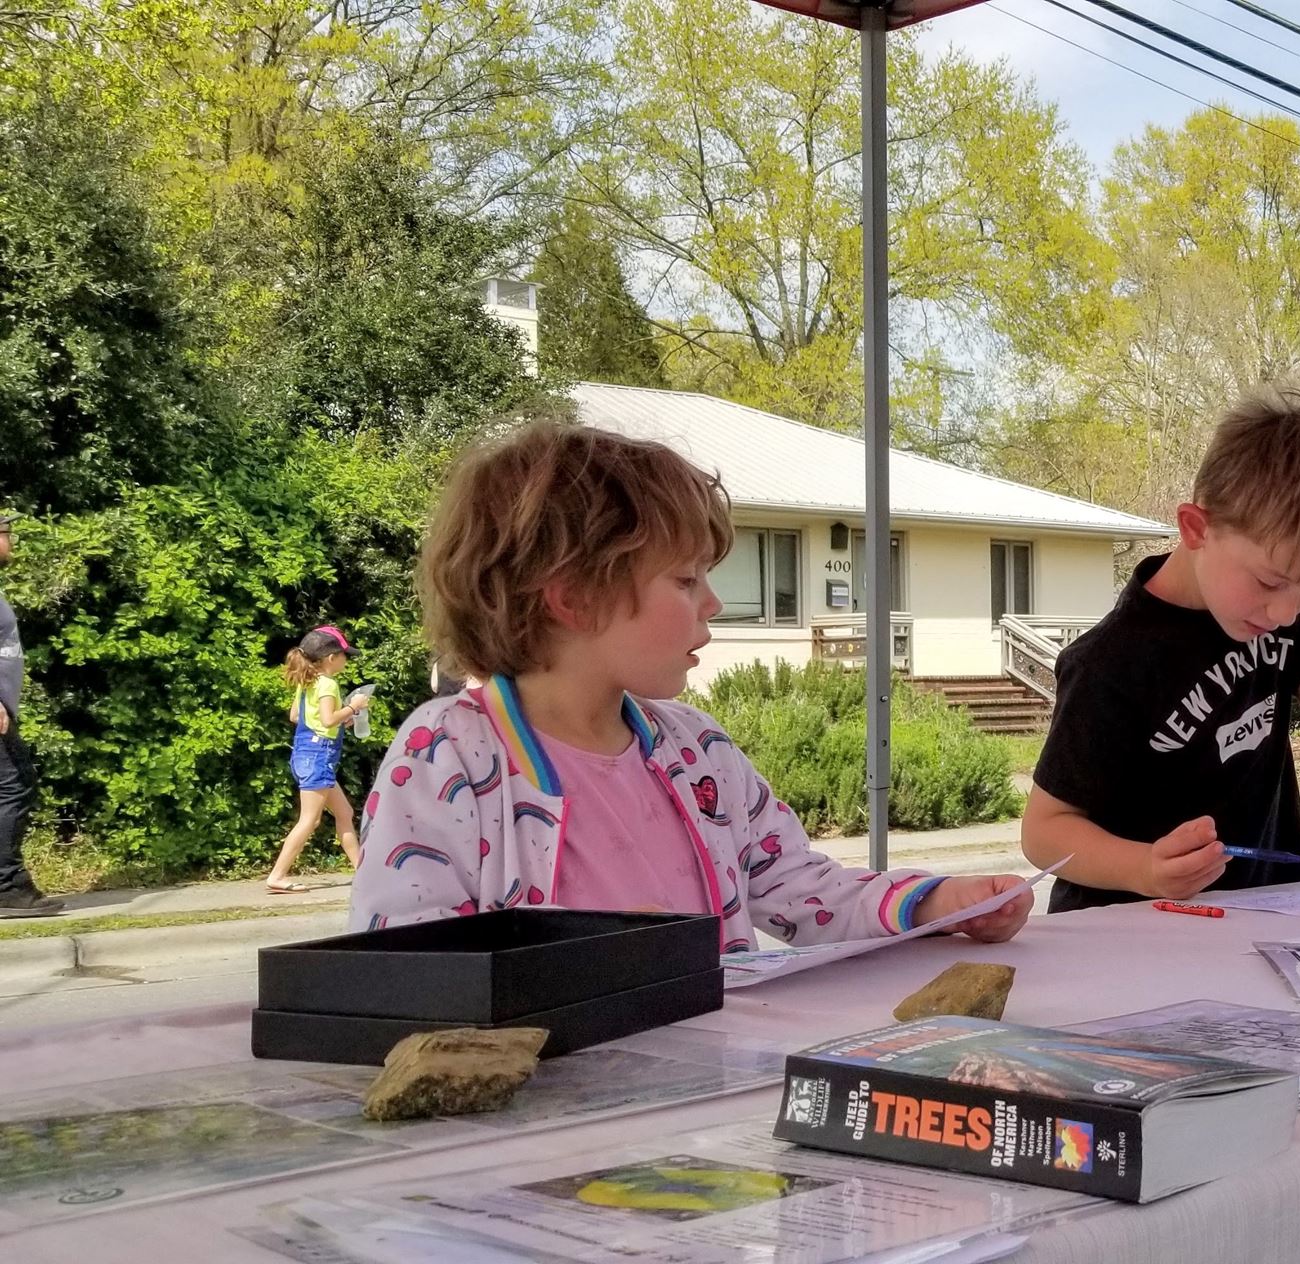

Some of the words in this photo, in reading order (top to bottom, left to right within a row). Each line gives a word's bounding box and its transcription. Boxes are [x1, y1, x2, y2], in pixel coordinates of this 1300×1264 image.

[825, 560, 851, 573] 400
[1149, 683, 1213, 752] NEW
[1224, 708, 1274, 748] Levi's
[807, 1080, 818, 1124] NATIONAL
[811, 1077, 826, 1128] WILDLIFE
[845, 1090, 859, 1127] FIELD
[859, 1080, 870, 1098] TO
[853, 1100, 869, 1140] GUIDE
[872, 1091, 992, 1151] TREES
[995, 1100, 1006, 1147] NORTH
[1003, 1105, 1017, 1167] AMERICA
[1019, 1118, 1028, 1156] Kershner
[1027, 1120, 1036, 1157] Mathews
[1035, 1125, 1044, 1154] Nelson
[991, 1148, 1002, 1168] OF
[1043, 1117, 1053, 1166] Spellenberg
[1118, 1131, 1126, 1177] STERLING
